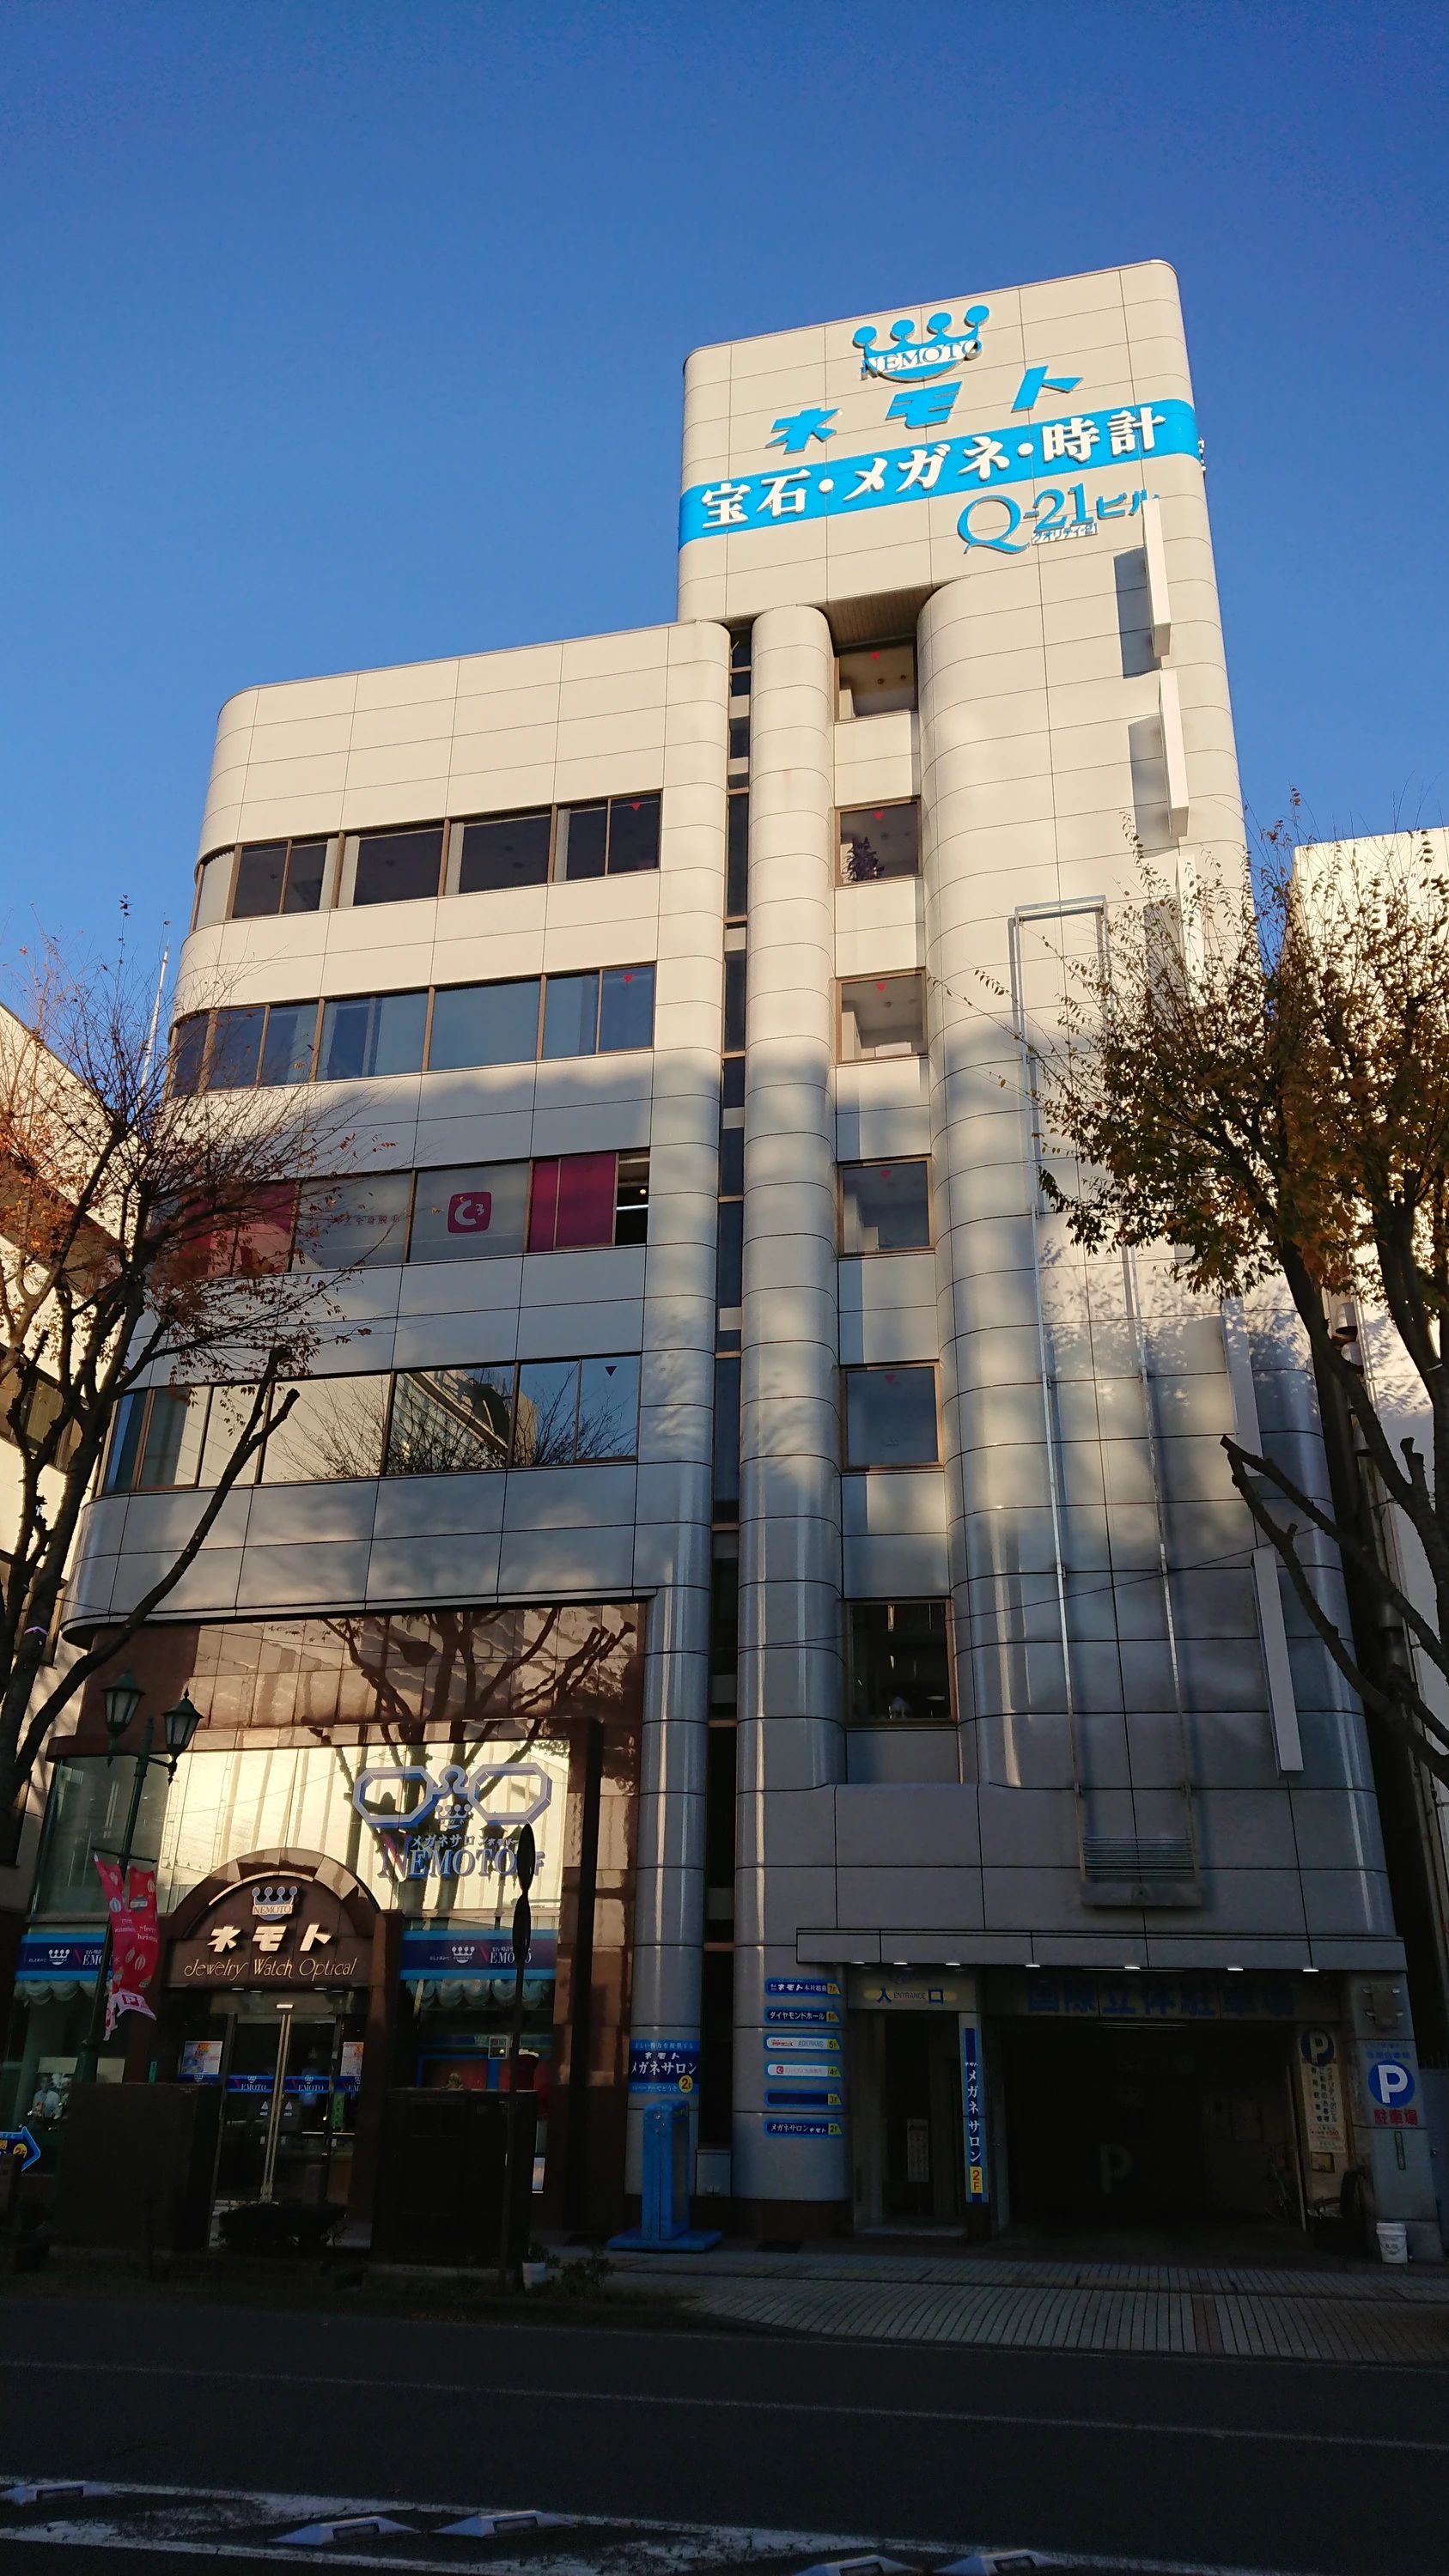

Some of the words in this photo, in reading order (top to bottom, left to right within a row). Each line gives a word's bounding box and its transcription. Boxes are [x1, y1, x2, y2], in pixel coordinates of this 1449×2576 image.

[860, 339, 982, 380] NEMOTO
[765, 376, 1084, 454] ネモト
[700, 405, 1166, 529] 宝石・メガネ・時計
[378, 1832, 518, 1881] NEMOTO
[253, 1905, 293, 1915] NEMOTO
[207, 1923, 333, 1953] ネモト
[183, 1957, 249, 1981] Jewelry
[252, 1955, 294, 1979] Watch
[299, 1957, 358, 1981] Optical
[893, 1991, 926, 2000] ENTRANCE
[928, 1988, 944, 2004] 口
[769, 2011, 825, 2020] ダイヤモンドホール
[644, 2051, 680, 2060] ネモト
[1309, 2032, 1329, 2065] P
[630, 2060, 697, 2075] メガネサロン
[1378, 2064, 1409, 2104] P
[967, 2069, 982, 2163] メガネサロン
[1373, 2109, 1419, 2125] 駐車場
